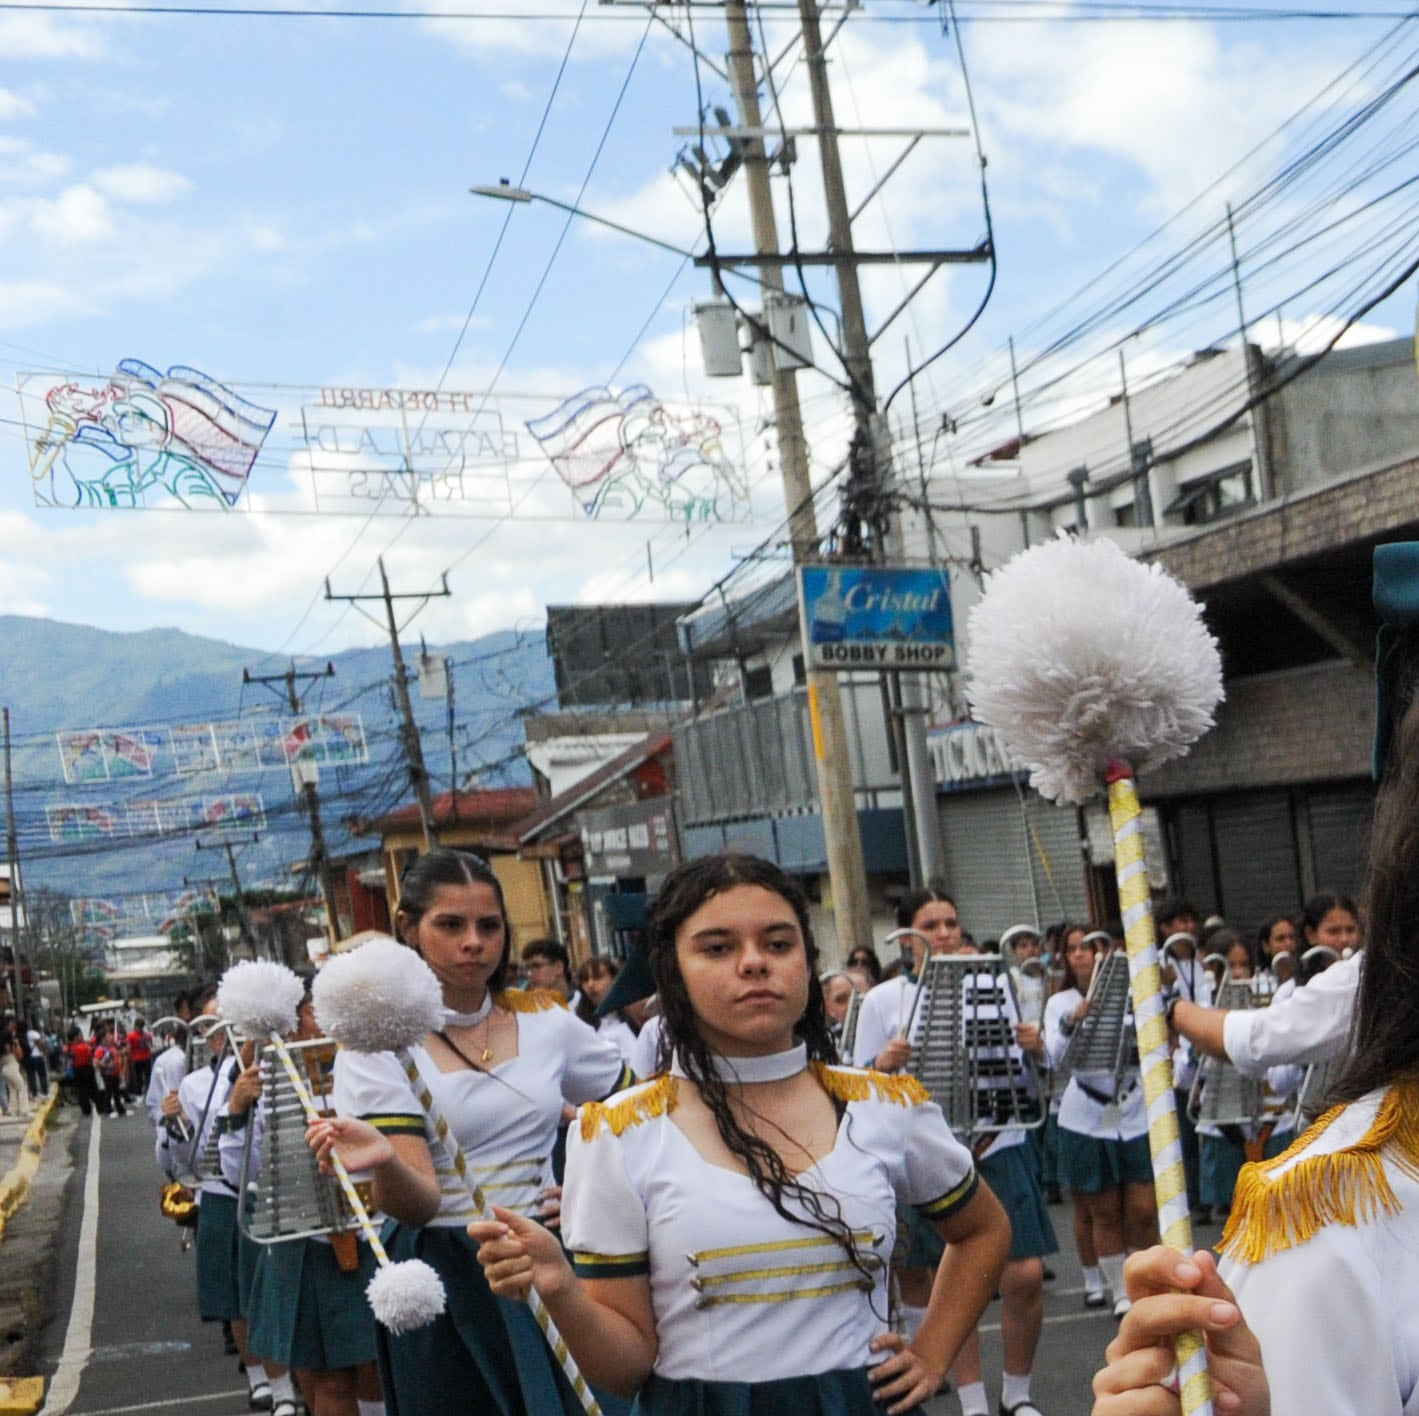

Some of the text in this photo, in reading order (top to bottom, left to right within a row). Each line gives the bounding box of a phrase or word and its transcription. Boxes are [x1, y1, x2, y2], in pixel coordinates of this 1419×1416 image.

[844, 583, 940, 613] Cristal
[821, 642, 946, 661] BOBBY SHOP
